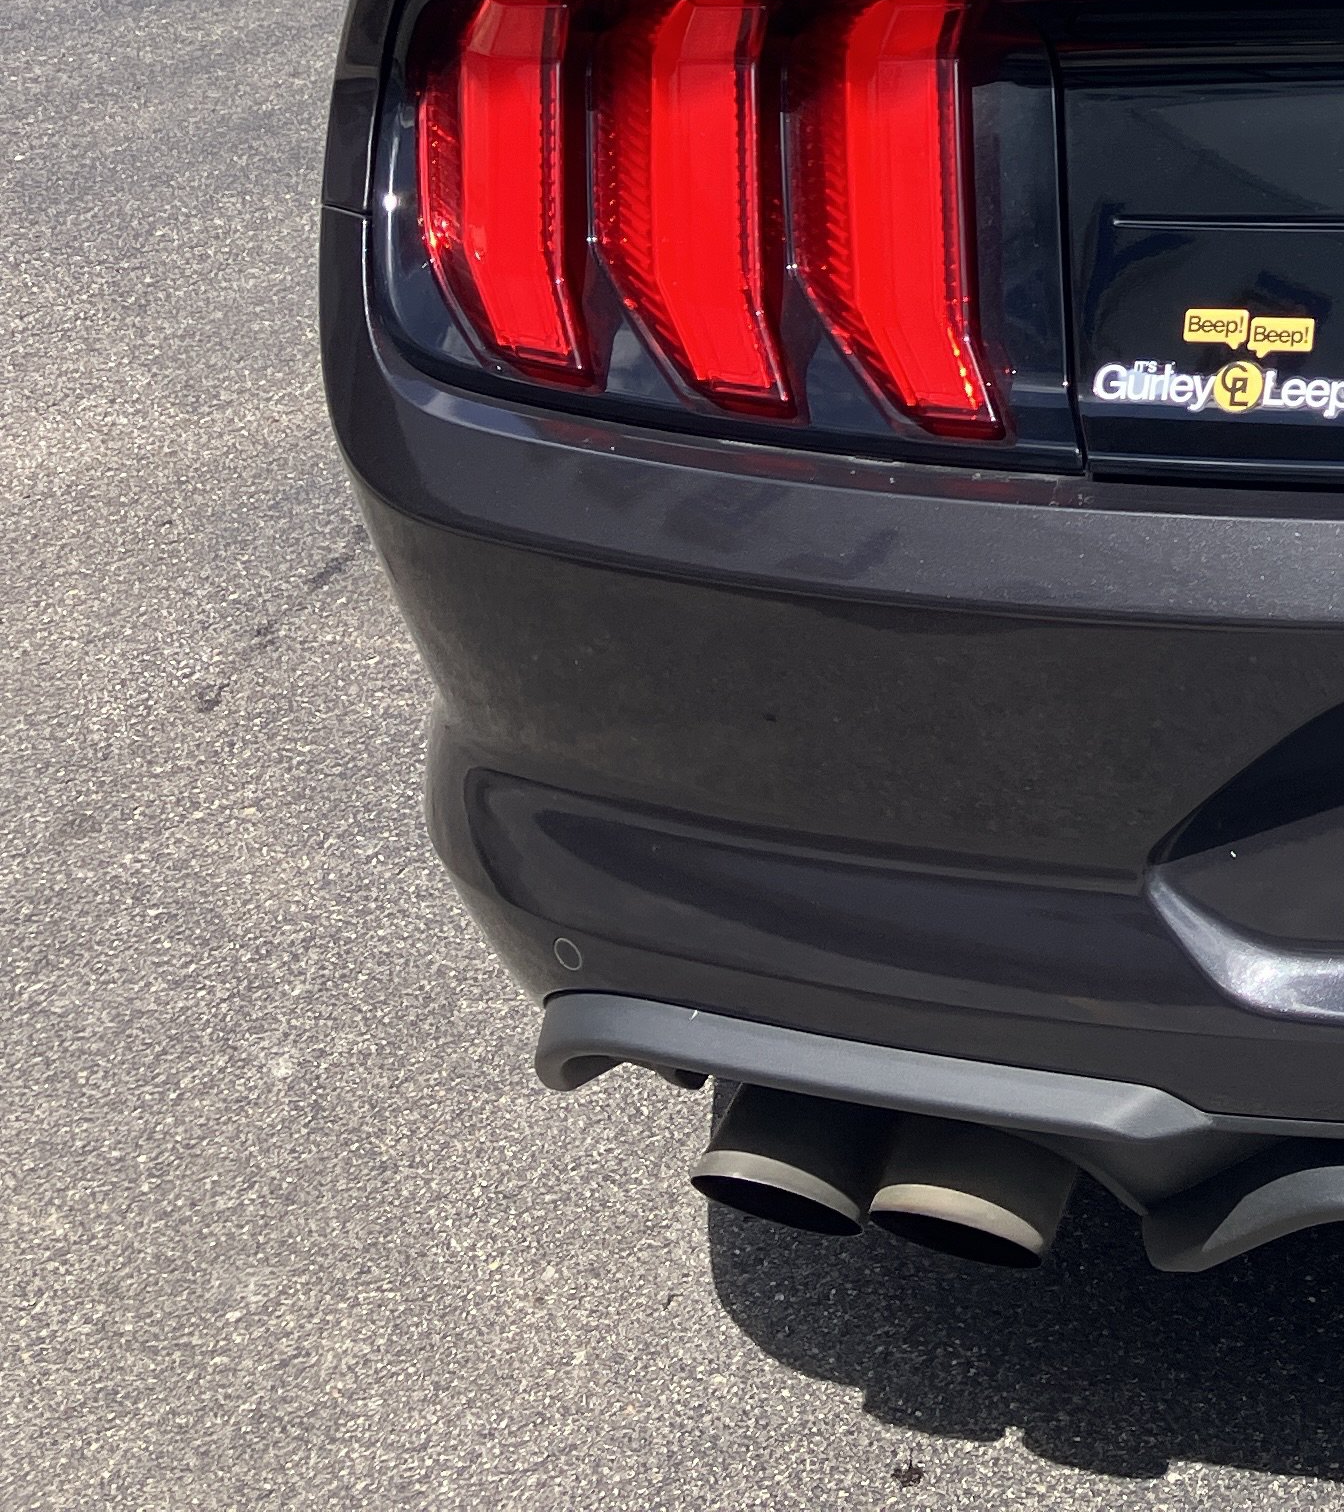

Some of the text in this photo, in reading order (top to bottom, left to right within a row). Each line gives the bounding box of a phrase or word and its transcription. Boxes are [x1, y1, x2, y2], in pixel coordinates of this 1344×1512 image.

[1188, 315, 1244, 338] Beep!
[1253, 325, 1310, 346] Beep!
[1093, 363, 1217, 412] Gurley
